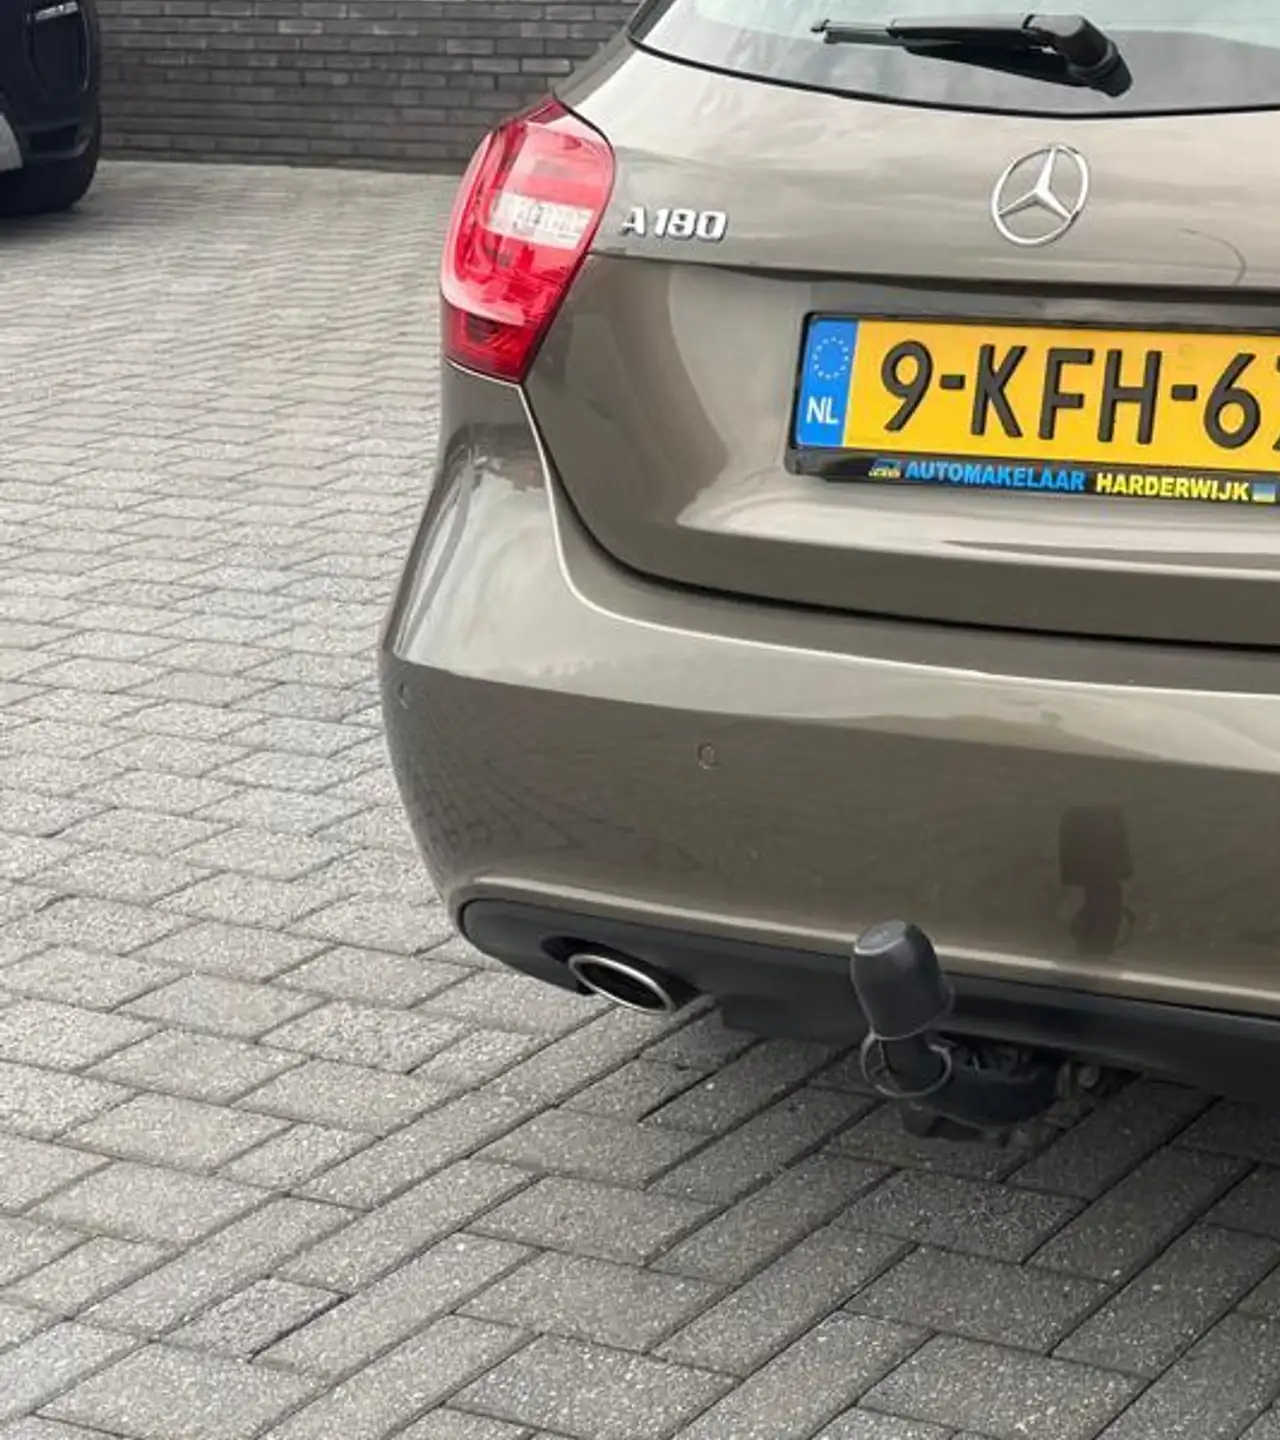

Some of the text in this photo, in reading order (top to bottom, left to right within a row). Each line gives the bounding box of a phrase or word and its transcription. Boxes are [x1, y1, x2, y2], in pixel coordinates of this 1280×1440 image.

[619, 206, 727, 242] A 180
[806, 396, 839, 424] NL
[905, 461, 1085, 492] AUTOMAKELAAR
[1096, 472, 1249, 502] HARDERWIJK
